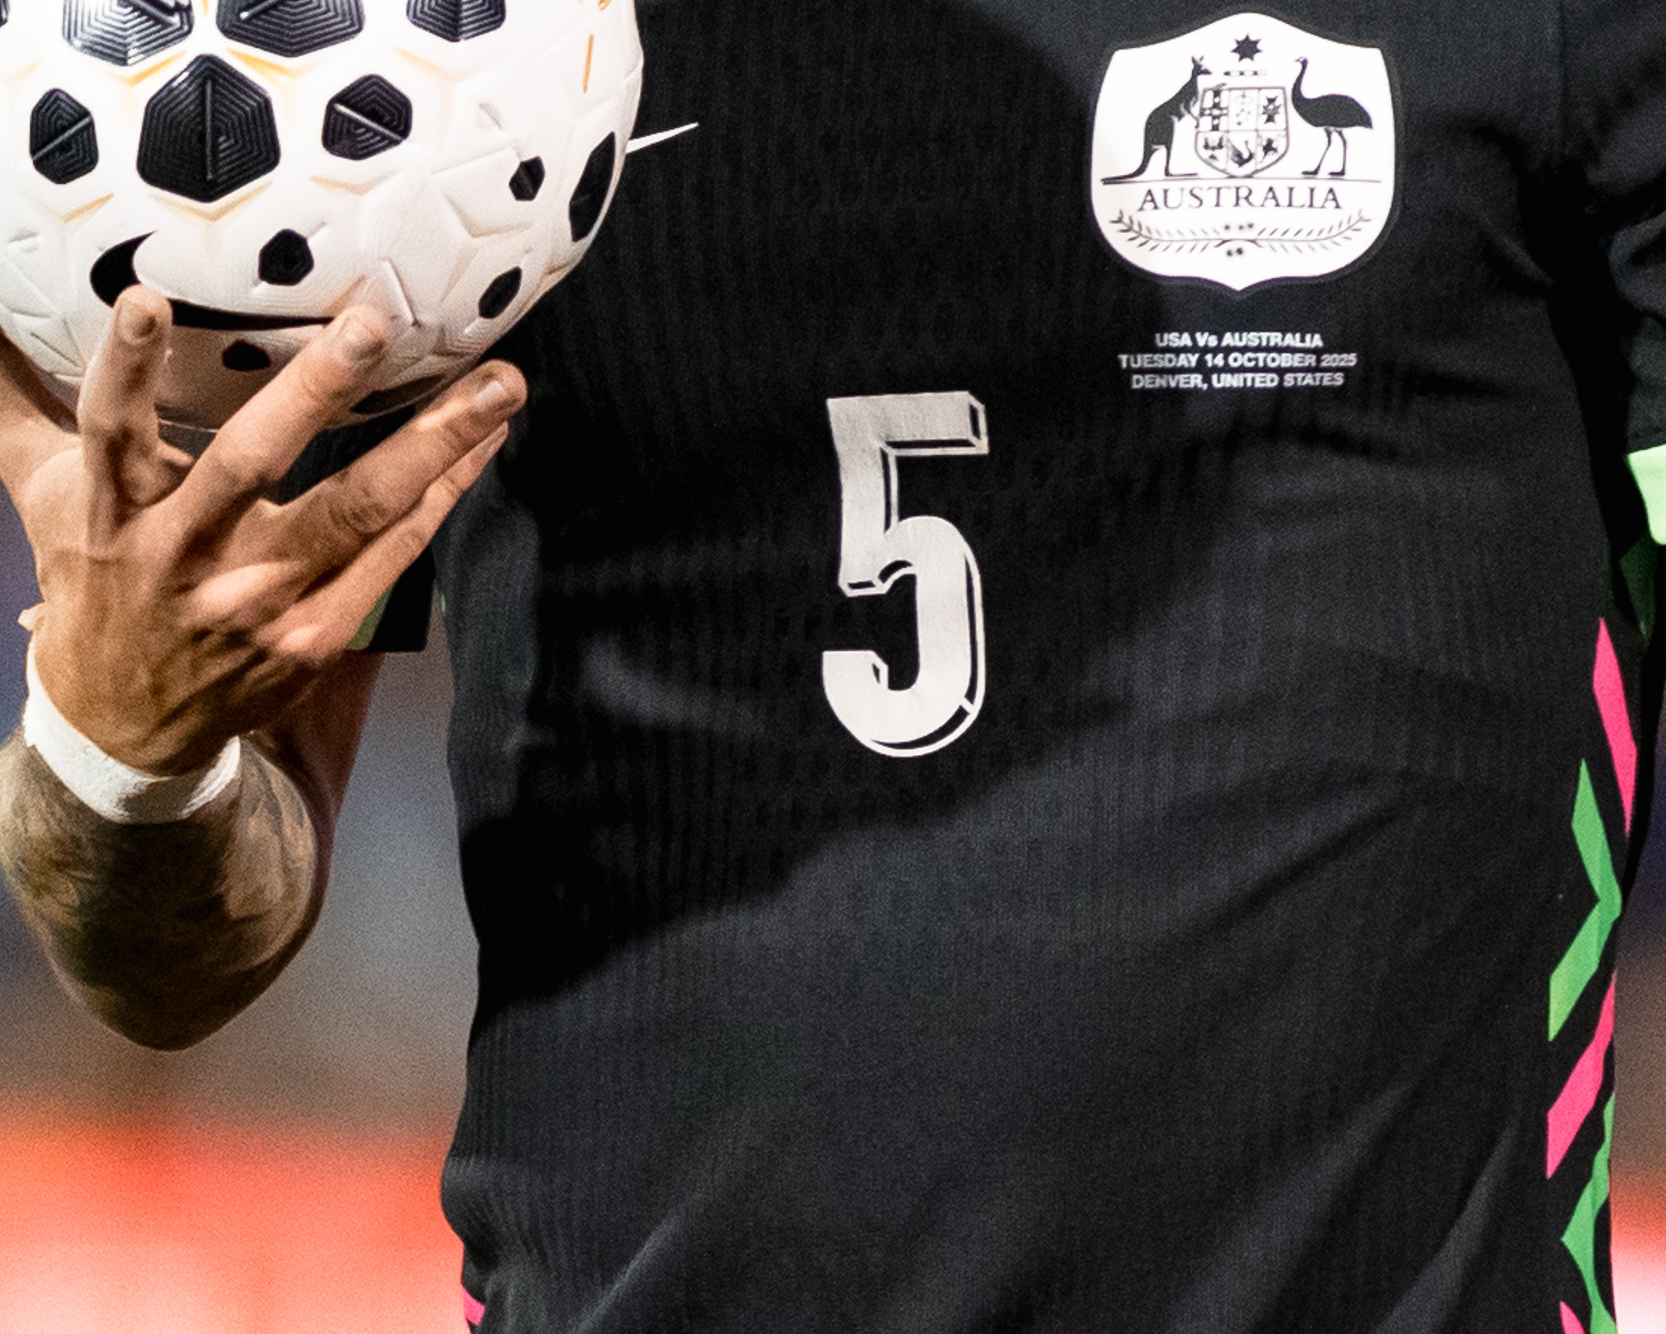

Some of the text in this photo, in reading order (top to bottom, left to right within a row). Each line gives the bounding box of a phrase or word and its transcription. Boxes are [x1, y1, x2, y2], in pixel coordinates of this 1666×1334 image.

[1137, 185, 1343, 212] AUSTRALIA
[1154, 332, 1324, 348] USA Vs AUSTRALIA
[1118, 353, 1358, 368] TUESDAY 14 OCTOBER 2025
[1131, 372, 1345, 390] DENVER, UNITED STATES
[821, 390, 989, 758] 5
